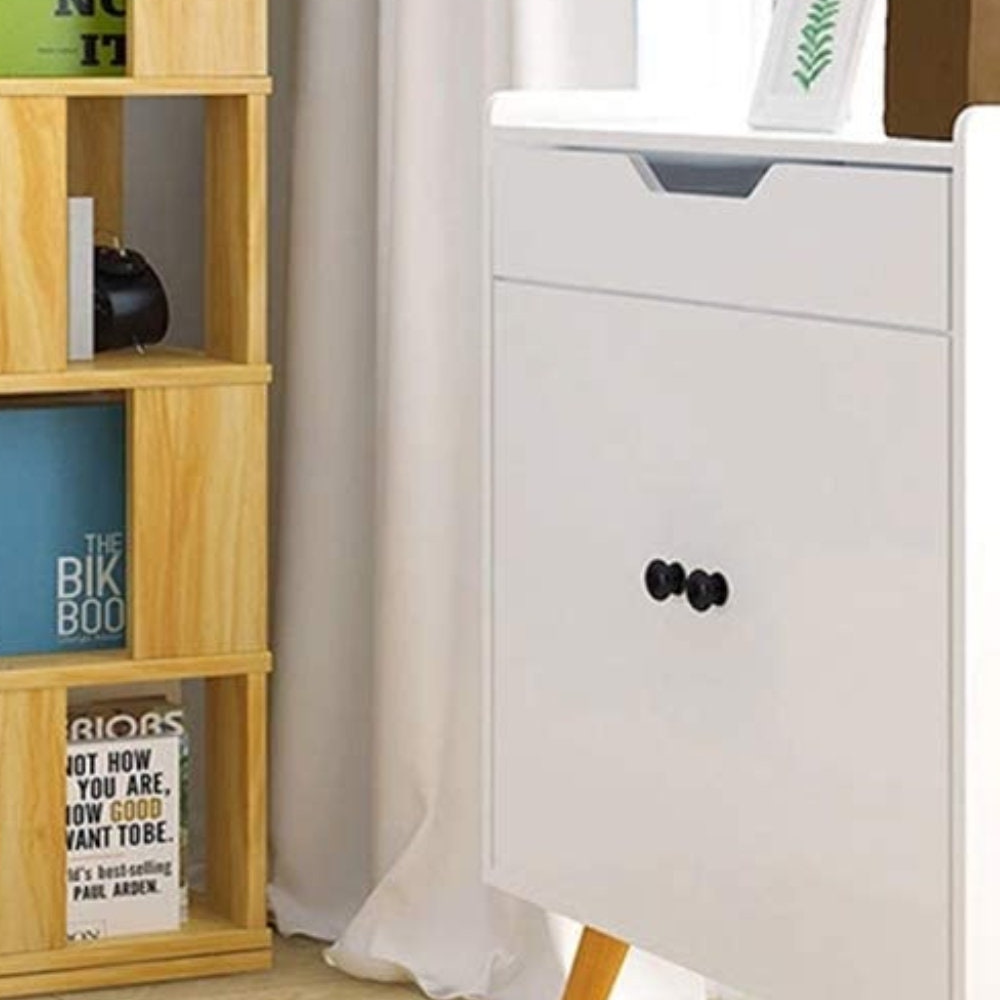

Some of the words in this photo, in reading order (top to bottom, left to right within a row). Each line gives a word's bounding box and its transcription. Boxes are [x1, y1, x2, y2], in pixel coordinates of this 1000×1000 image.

[84, 532, 123, 554] THE
[107, 748, 152, 775] HOW
[77, 776, 116, 800] YOU
[126, 771, 171, 797] ARE,
[110, 798, 162, 823] GOOD
[73, 884, 107, 901] PAUL
